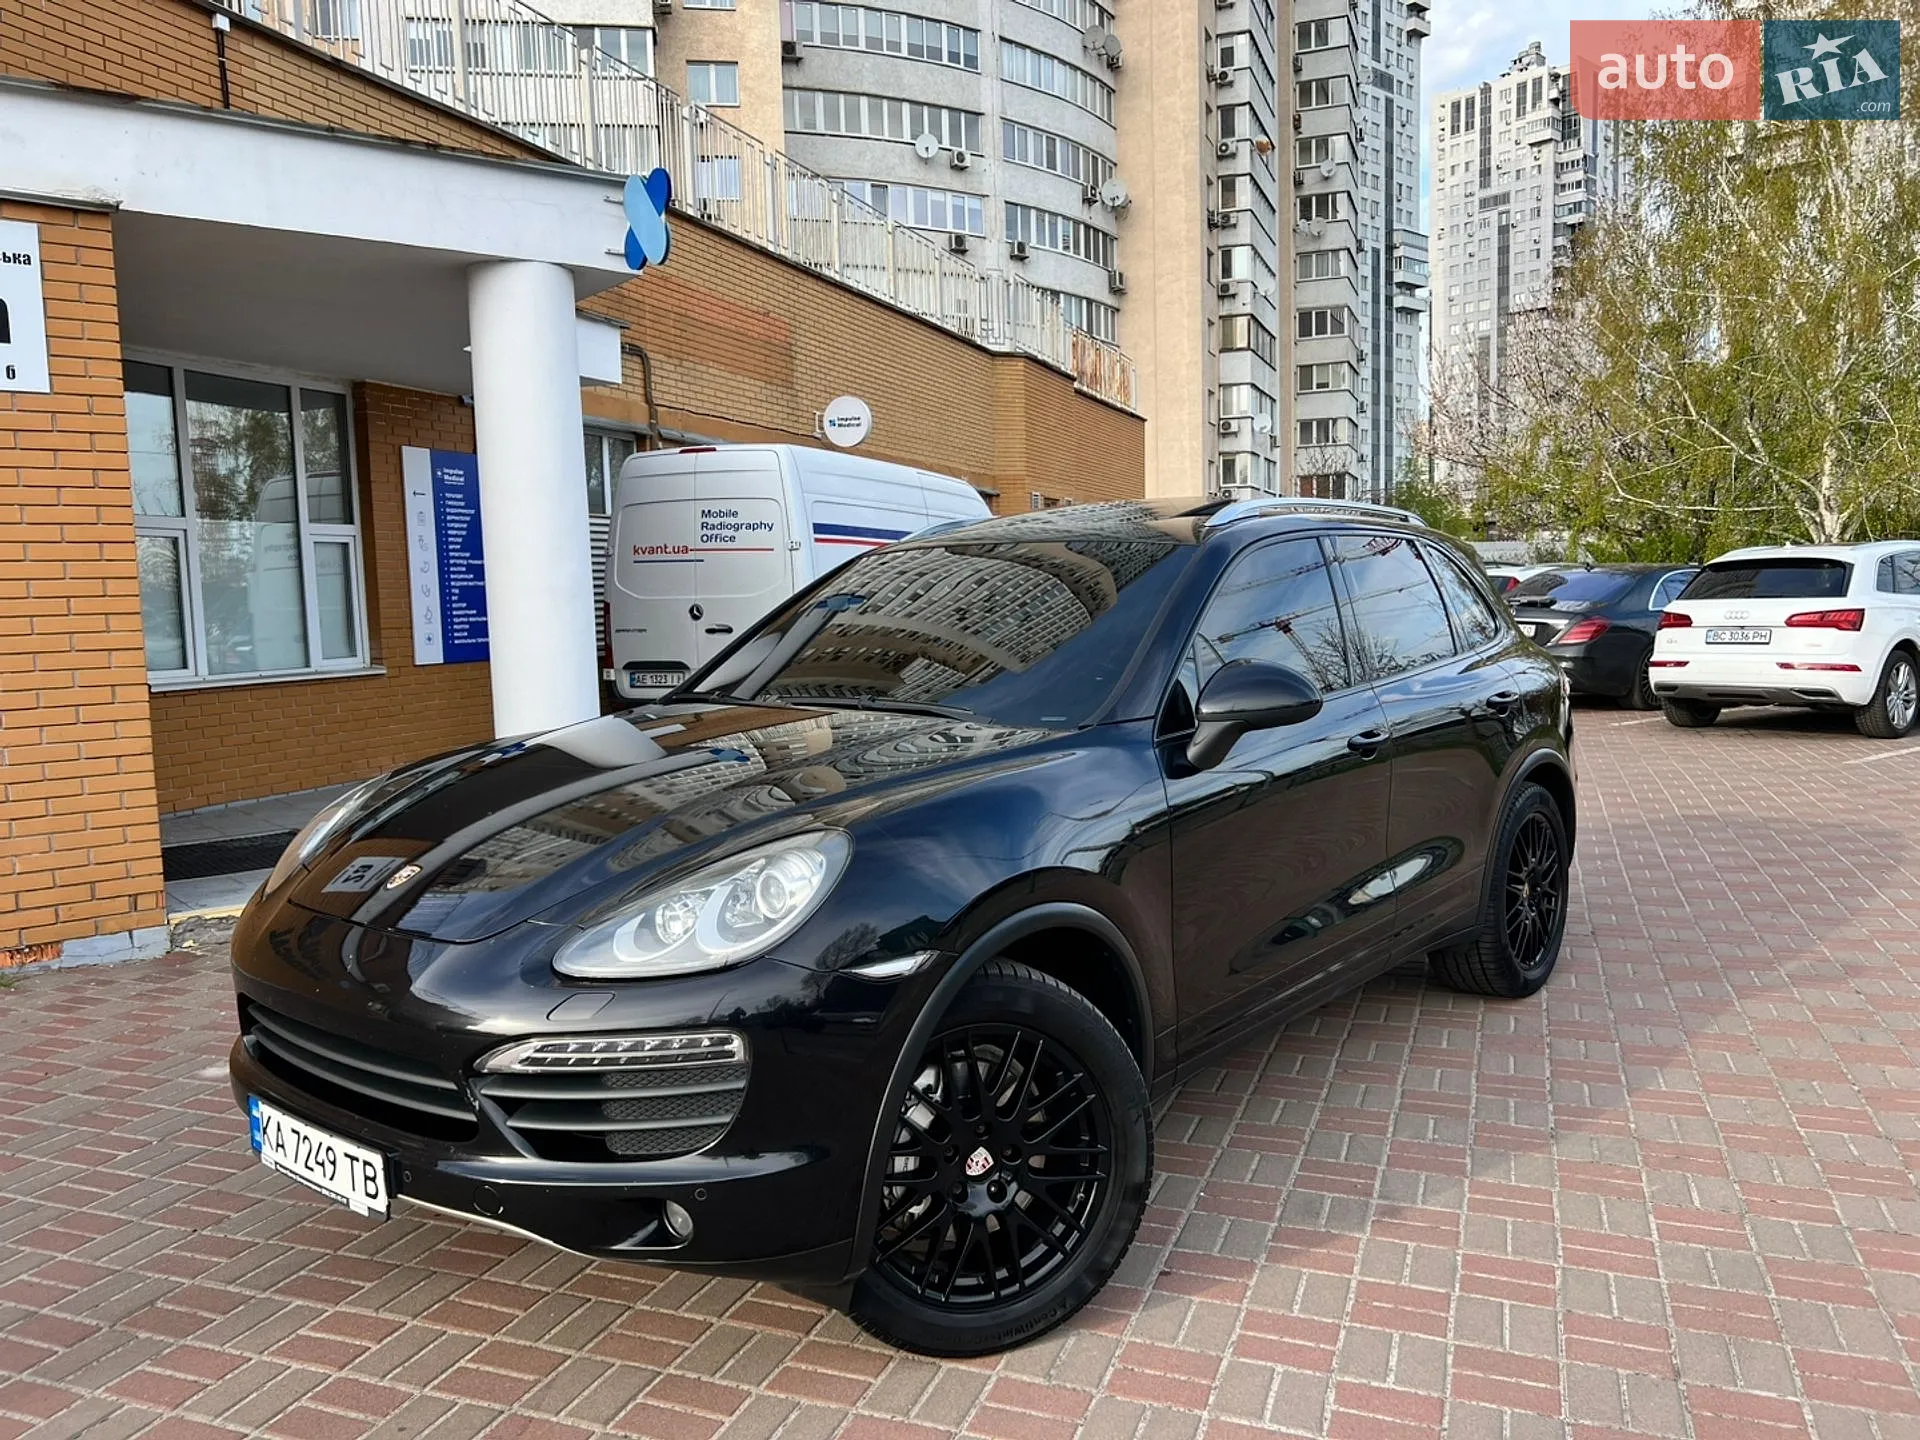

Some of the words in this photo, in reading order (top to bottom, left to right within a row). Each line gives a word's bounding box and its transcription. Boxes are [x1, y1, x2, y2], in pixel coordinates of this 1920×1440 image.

[0, 251, 32, 266] ька
[701, 509, 739, 519] Mobile
[701, 521, 775, 532] Radiography
[700, 533, 736, 543] Office
[632, 543, 689, 556] kvant.ua
[1712, 629, 1728, 641] BC
[1728, 629, 1750, 641] 3036
[1752, 629, 1768, 641] PH
[260, 1111, 288, 1158] KA
[290, 1127, 337, 1182] 7249
[343, 1151, 379, 1200] TB
